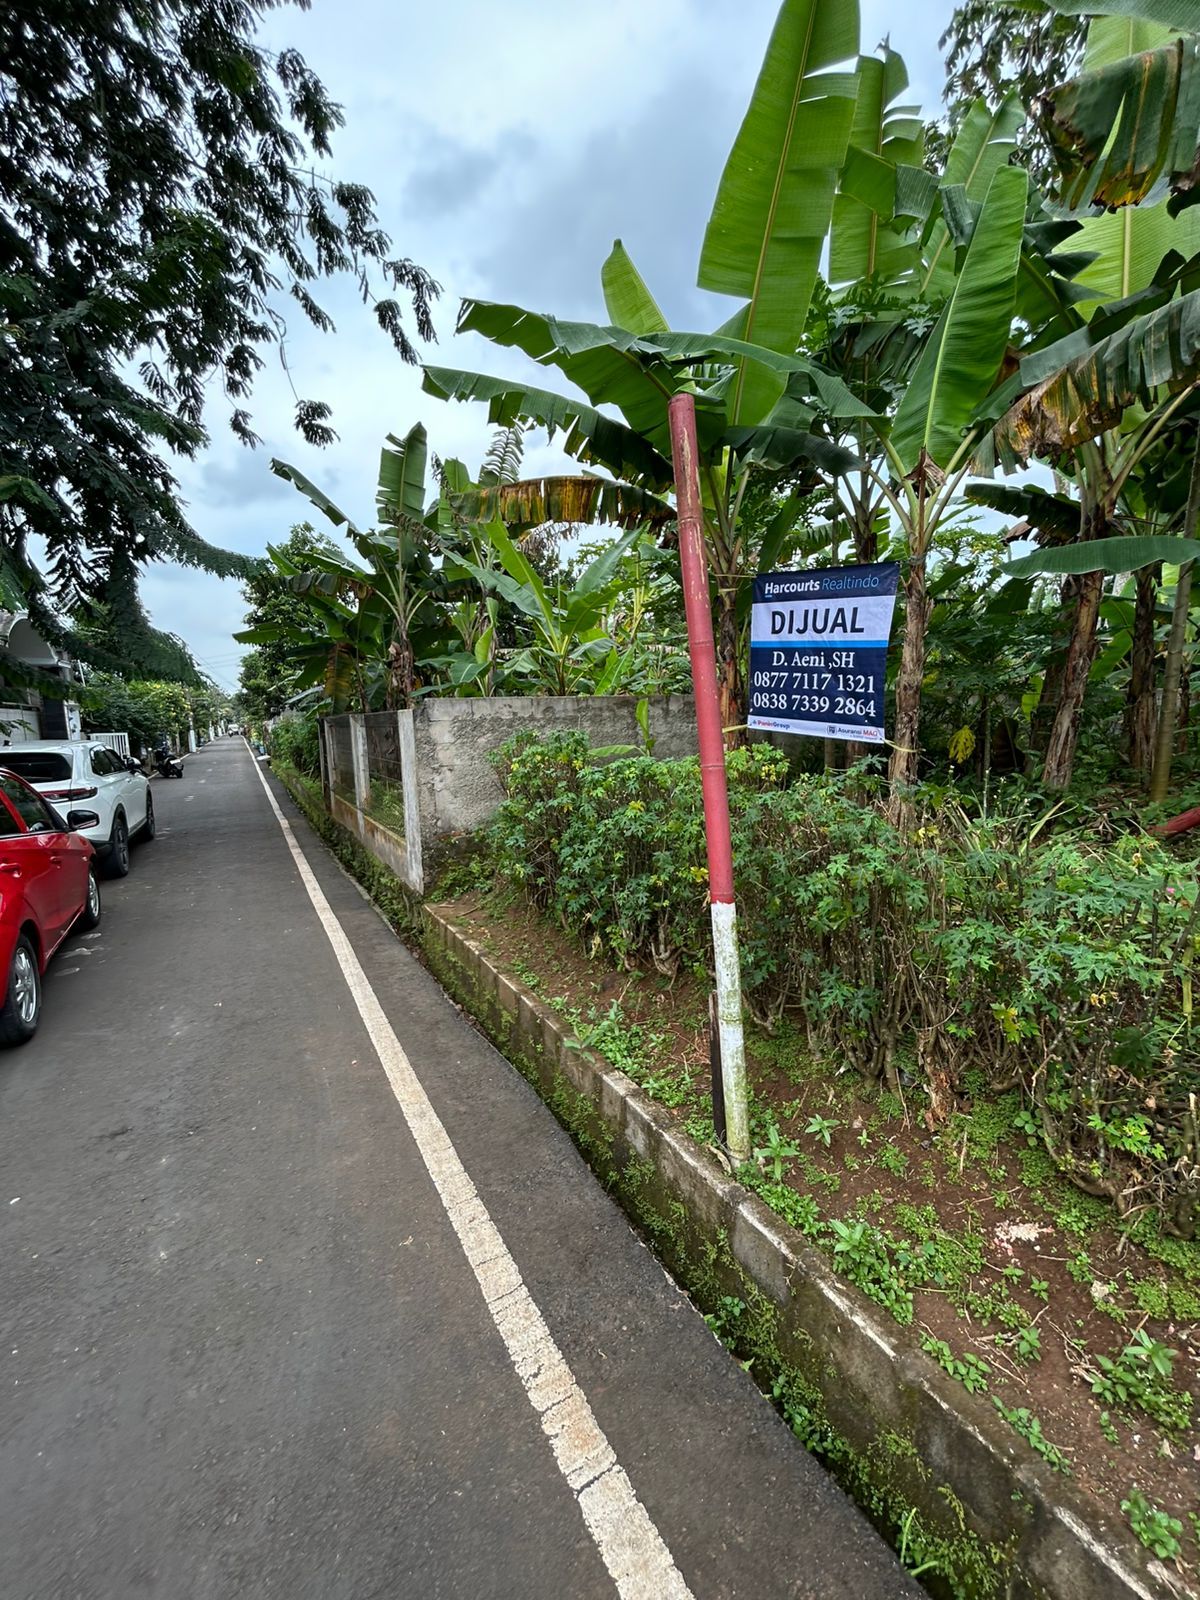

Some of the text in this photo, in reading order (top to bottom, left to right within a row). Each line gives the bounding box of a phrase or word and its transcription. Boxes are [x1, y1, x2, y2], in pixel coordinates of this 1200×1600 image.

[764, 574, 880, 595] Harcourts Realtindo
[771, 606, 865, 635] DIJUAL
[772, 651, 788, 667] D.
[791, 651, 825, 667] Aeni
[753, 671, 875, 694] 0877 7117 1321
[753, 691, 876, 717] 0838 7339 2864
